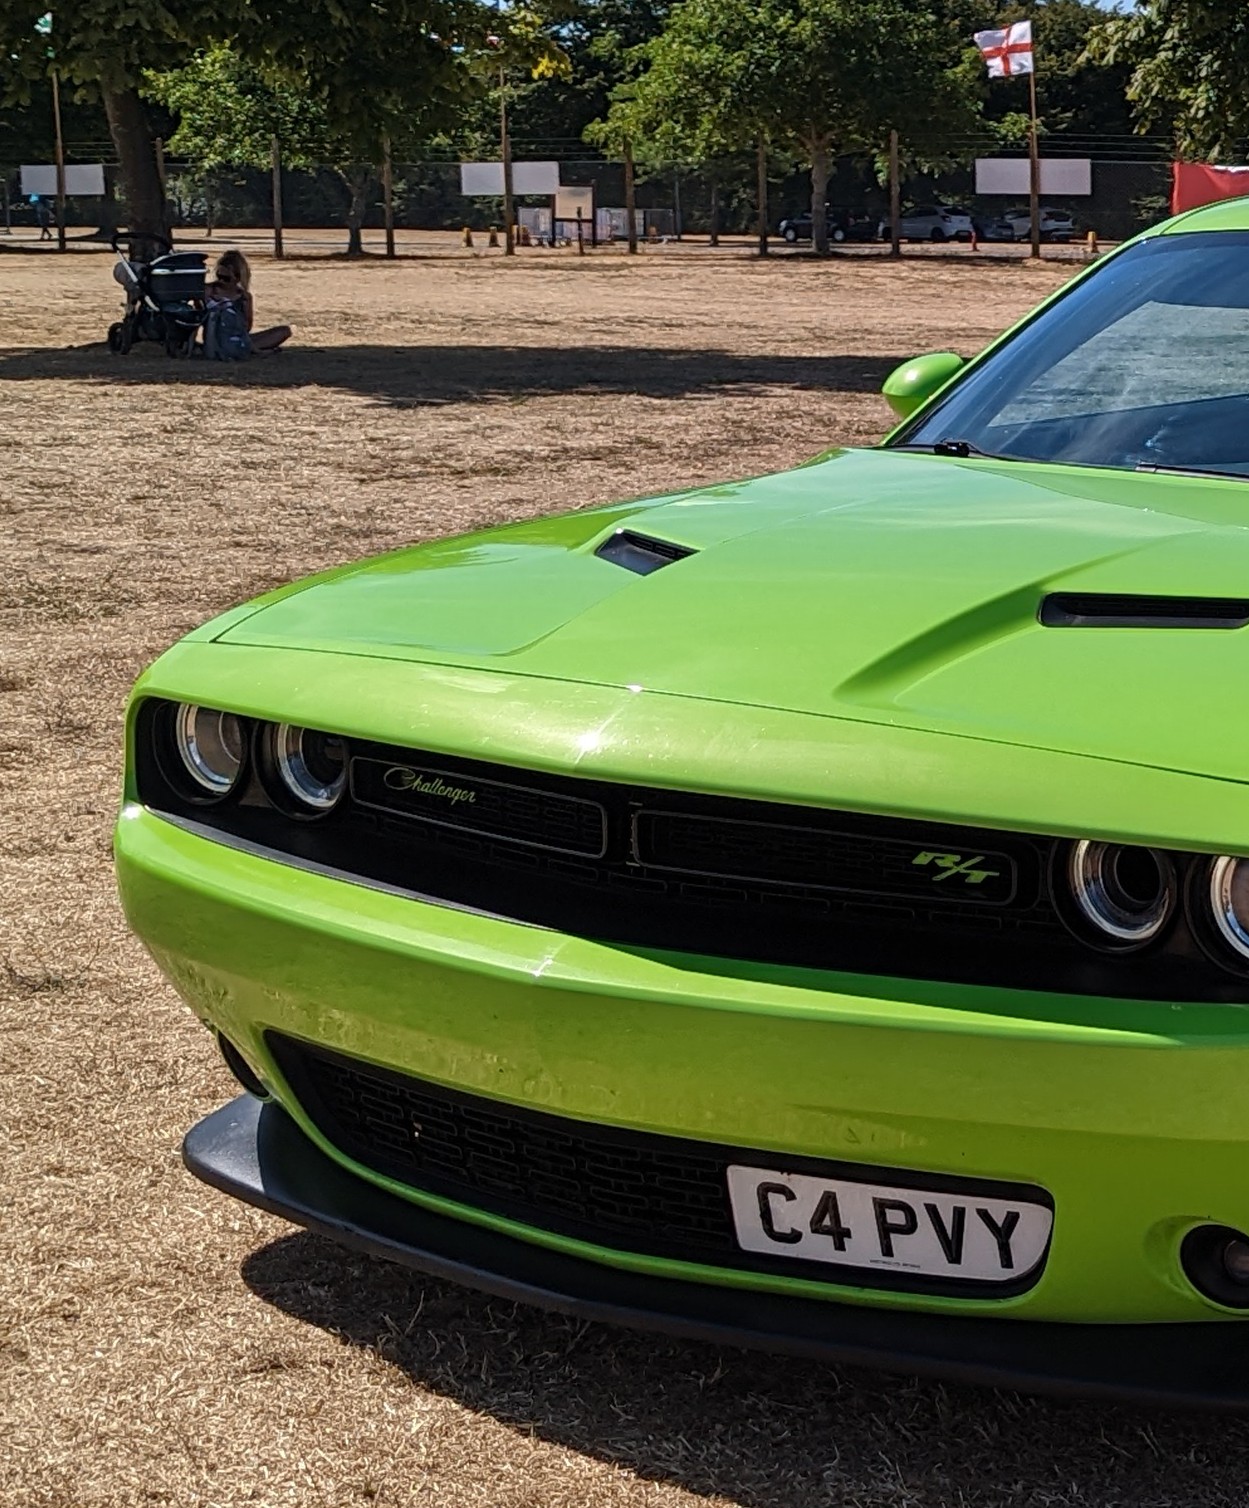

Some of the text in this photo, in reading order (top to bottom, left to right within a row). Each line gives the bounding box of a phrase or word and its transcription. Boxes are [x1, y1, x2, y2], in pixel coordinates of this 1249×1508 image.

[383, 767, 477, 806] Challenger
[911, 850, 1001, 884] R/T
[756, 1181, 1021, 1270] C4 PVY
